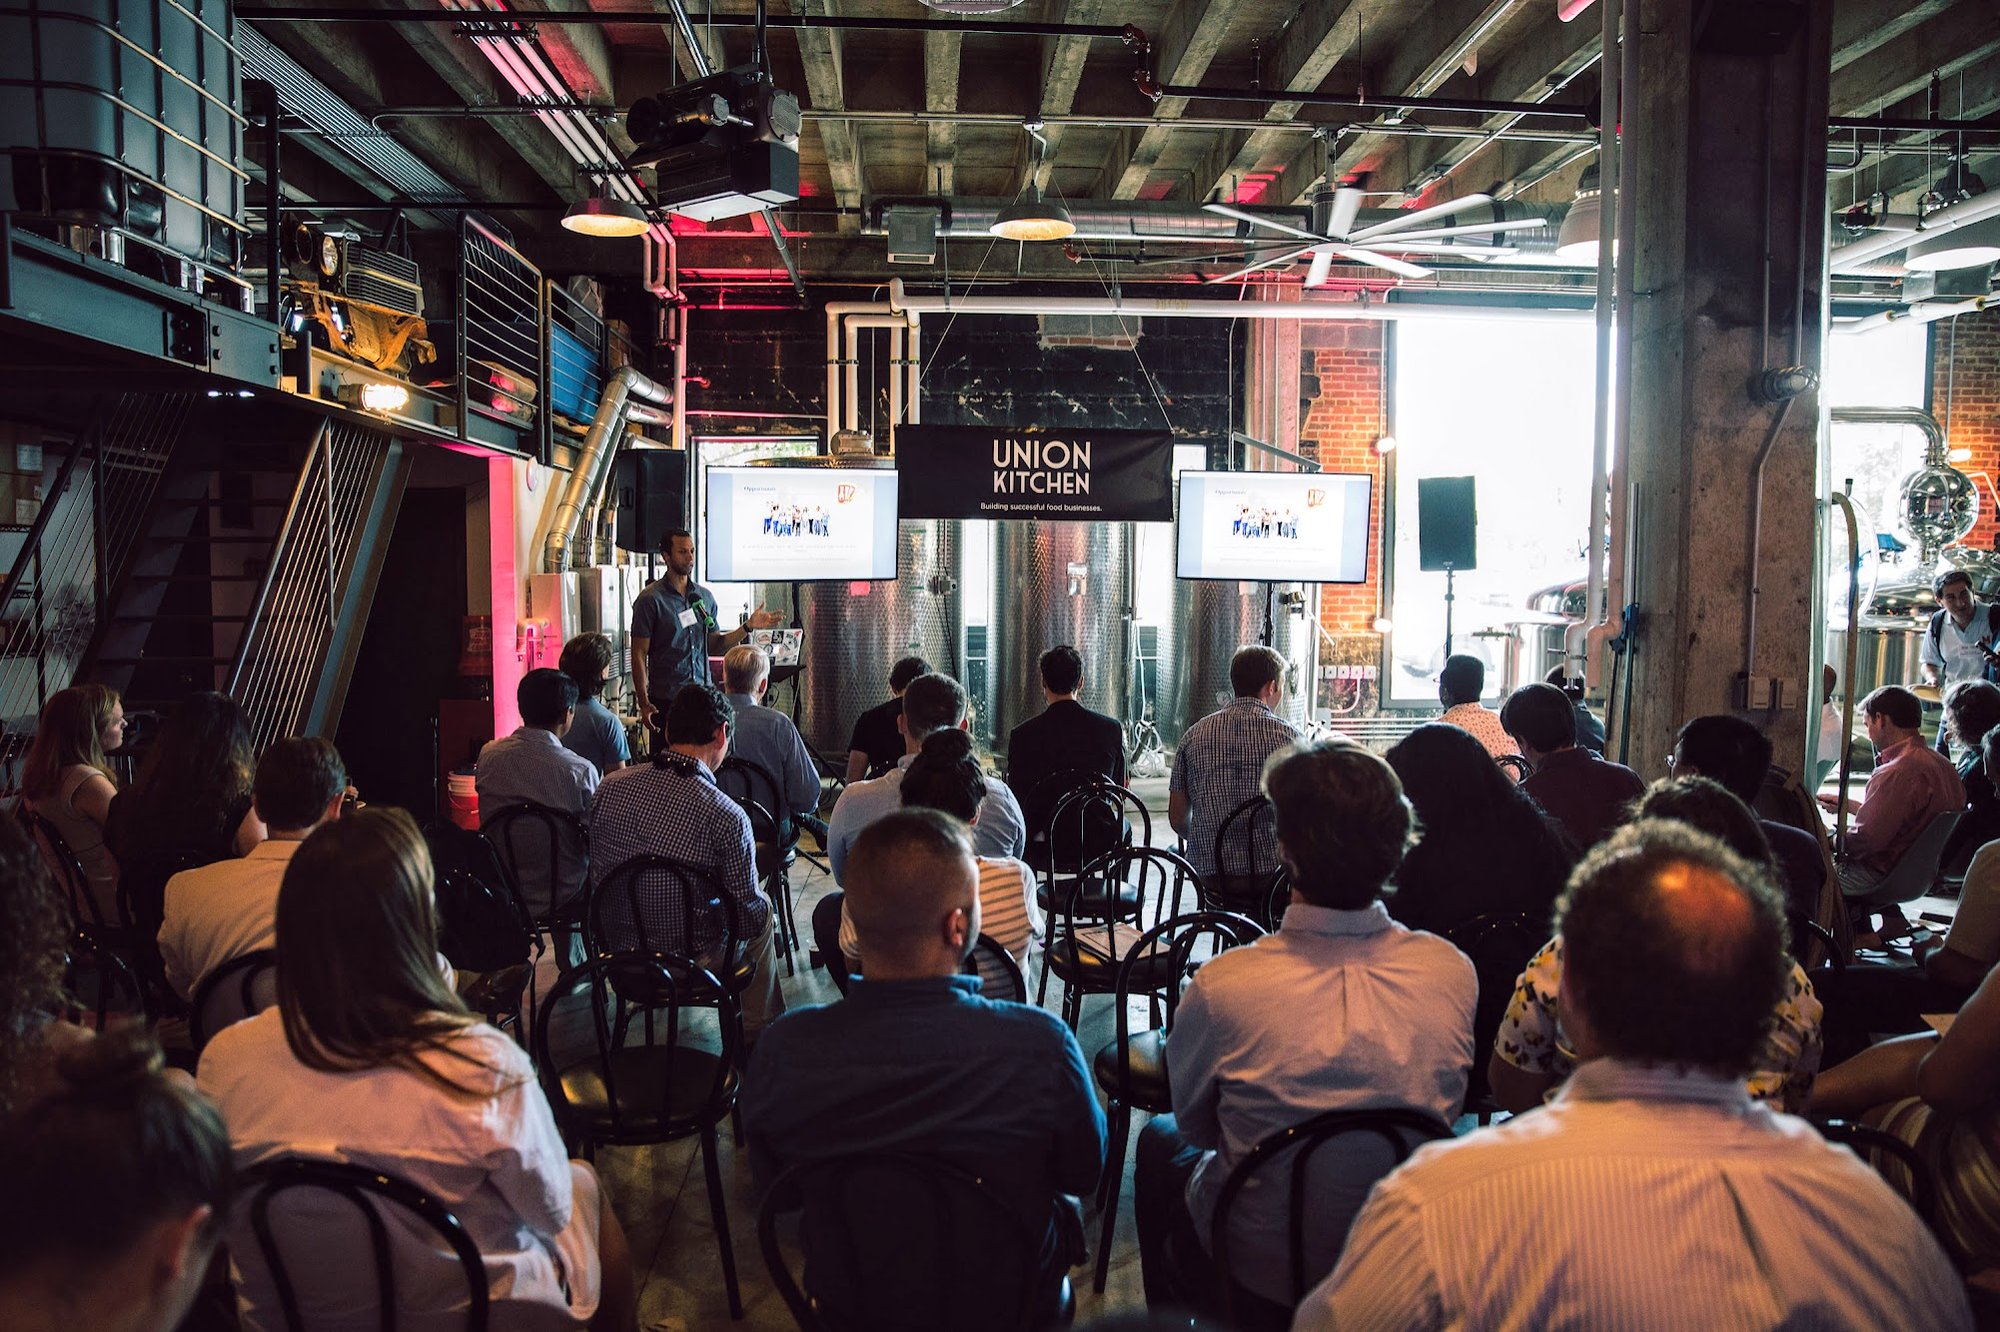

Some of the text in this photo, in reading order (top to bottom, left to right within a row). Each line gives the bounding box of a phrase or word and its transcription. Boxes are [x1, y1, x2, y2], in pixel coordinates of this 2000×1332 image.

[993, 439, 1091, 470] UNION
[993, 471, 1090, 495] KITCHEN
[980, 502, 1102, 512] Building successful food businesses.
